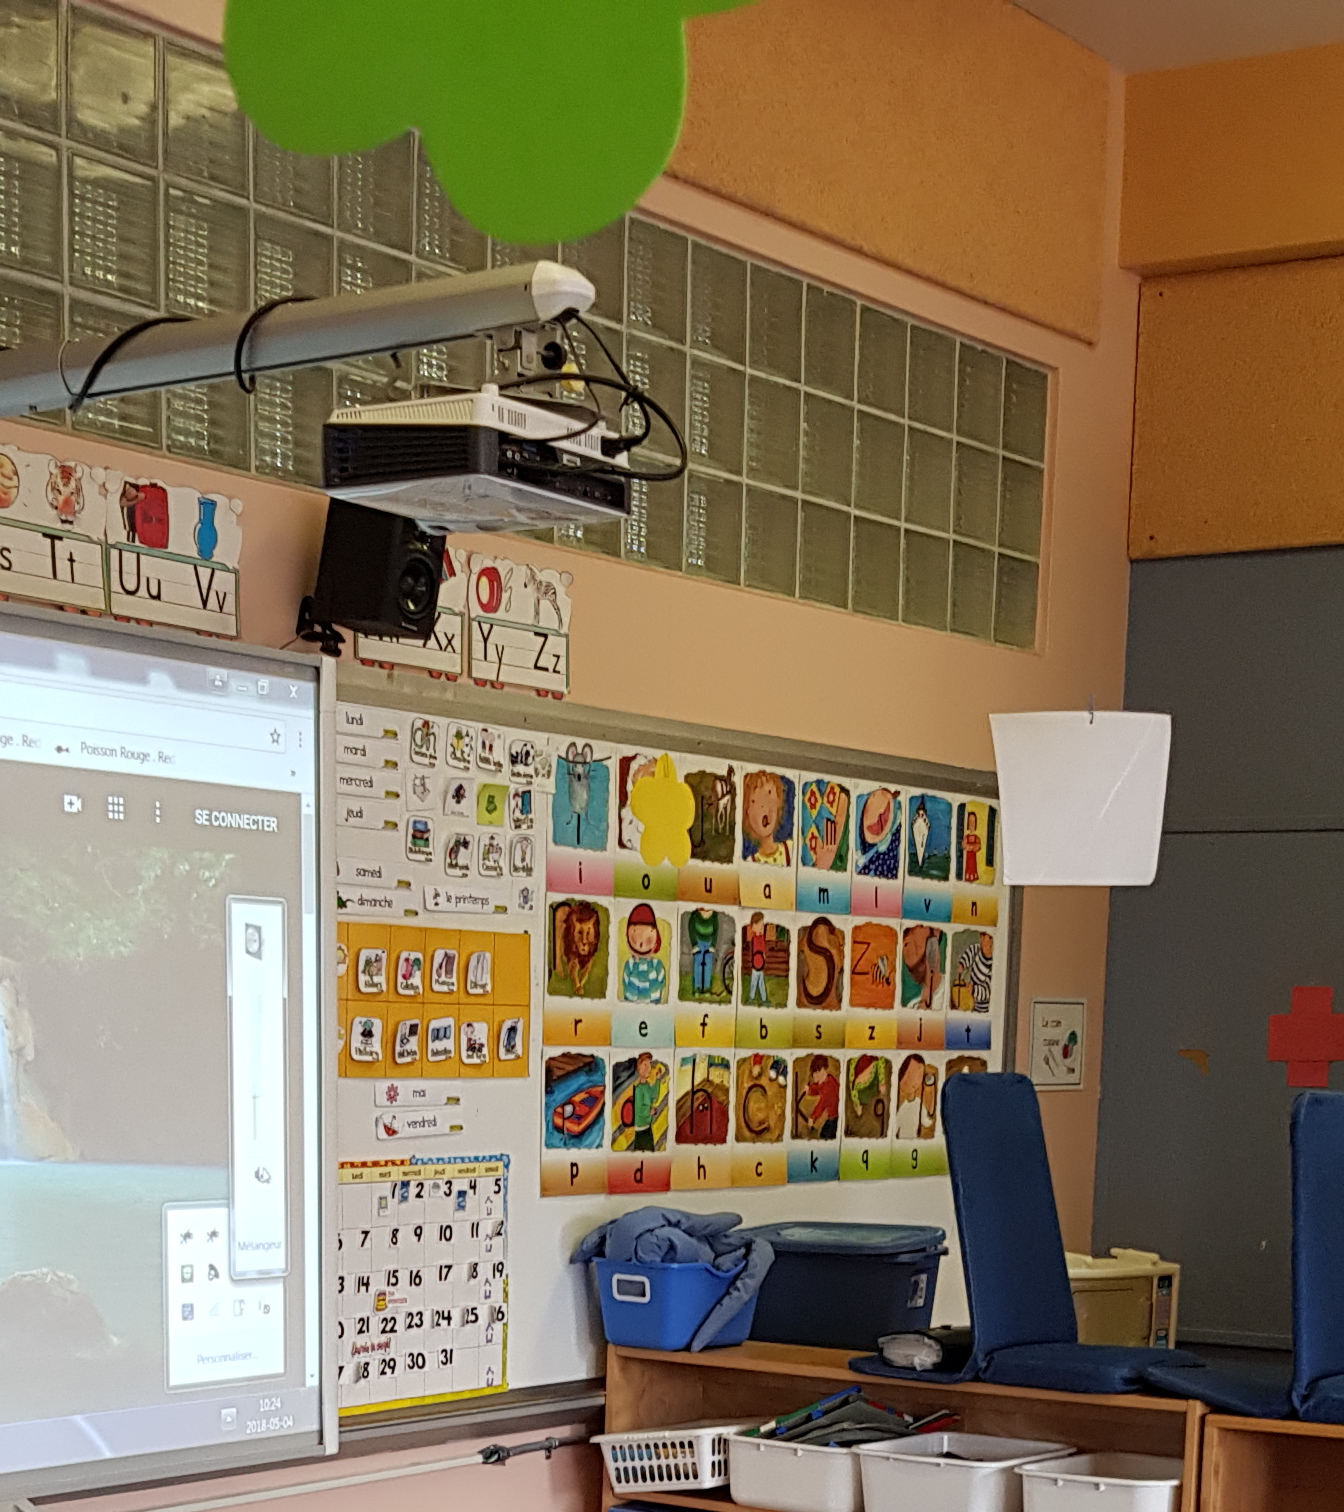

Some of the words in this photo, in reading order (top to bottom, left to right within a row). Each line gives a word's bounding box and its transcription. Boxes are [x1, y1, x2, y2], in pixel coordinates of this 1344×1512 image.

[345, 711, 364, 727] lundi
[80, 741, 118, 759] Poisson
[120, 745, 151, 765] Rouge
[343, 744, 367, 758] mardi
[339, 775, 374, 789] mercredi
[194, 808, 210, 826] SE
[211, 810, 278, 834] CONNECTER
[344, 806, 364, 823] jeudi
[355, 865, 383, 880] samedi
[445, 891, 453, 904] le
[454, 892, 490, 908] printemps
[577, 865, 584, 884] i
[763, 884, 771, 900] a
[818, 887, 830, 905] m
[969, 901, 978, 917] n
[357, 895, 394, 909] dimanche
[573, 1019, 583, 1036] r
[638, 1020, 649, 1038] e
[699, 1014, 709, 1039] f
[759, 1019, 768, 1040] b
[412, 1088, 427, 1099] mai
[406, 1115, 438, 1130] vendredi
[569, 1161, 580, 1185] p
[633, 1160, 644, 1184] d
[696, 1156, 707, 1180] h
[809, 1151, 819, 1173] k
[391, 1182, 397, 1200] 1
[415, 1181, 424, 1199] 2
[443, 1180, 453, 1197] 3
[469, 1178, 477, 1196] 4
[493, 1177, 502, 1194] 5
[360, 1230, 370, 1248] 7
[390, 1228, 399, 1246] 8
[413, 1225, 423, 1243] 9
[439, 1224, 453, 1242] 10
[471, 1221, 480, 1239] 11
[357, 1275, 370, 1293] 14
[387, 1269, 399, 1287] 15
[409, 1269, 422, 1287] 16
[439, 1264, 453, 1282] 17
[492, 1261, 505, 1279] 19
[356, 1315, 370, 1335] 21
[380, 1316, 397, 1335] 22
[406, 1311, 424, 1329] 23
[435, 1310, 452, 1327] 24
[379, 1357, 397, 1376] 29
[407, 1352, 426, 1370] 30
[440, 1348, 453, 1366] 31
[259, 1397, 281, 1412] 10:24
[245, 1415, 294, 1434] 2018-05-04
